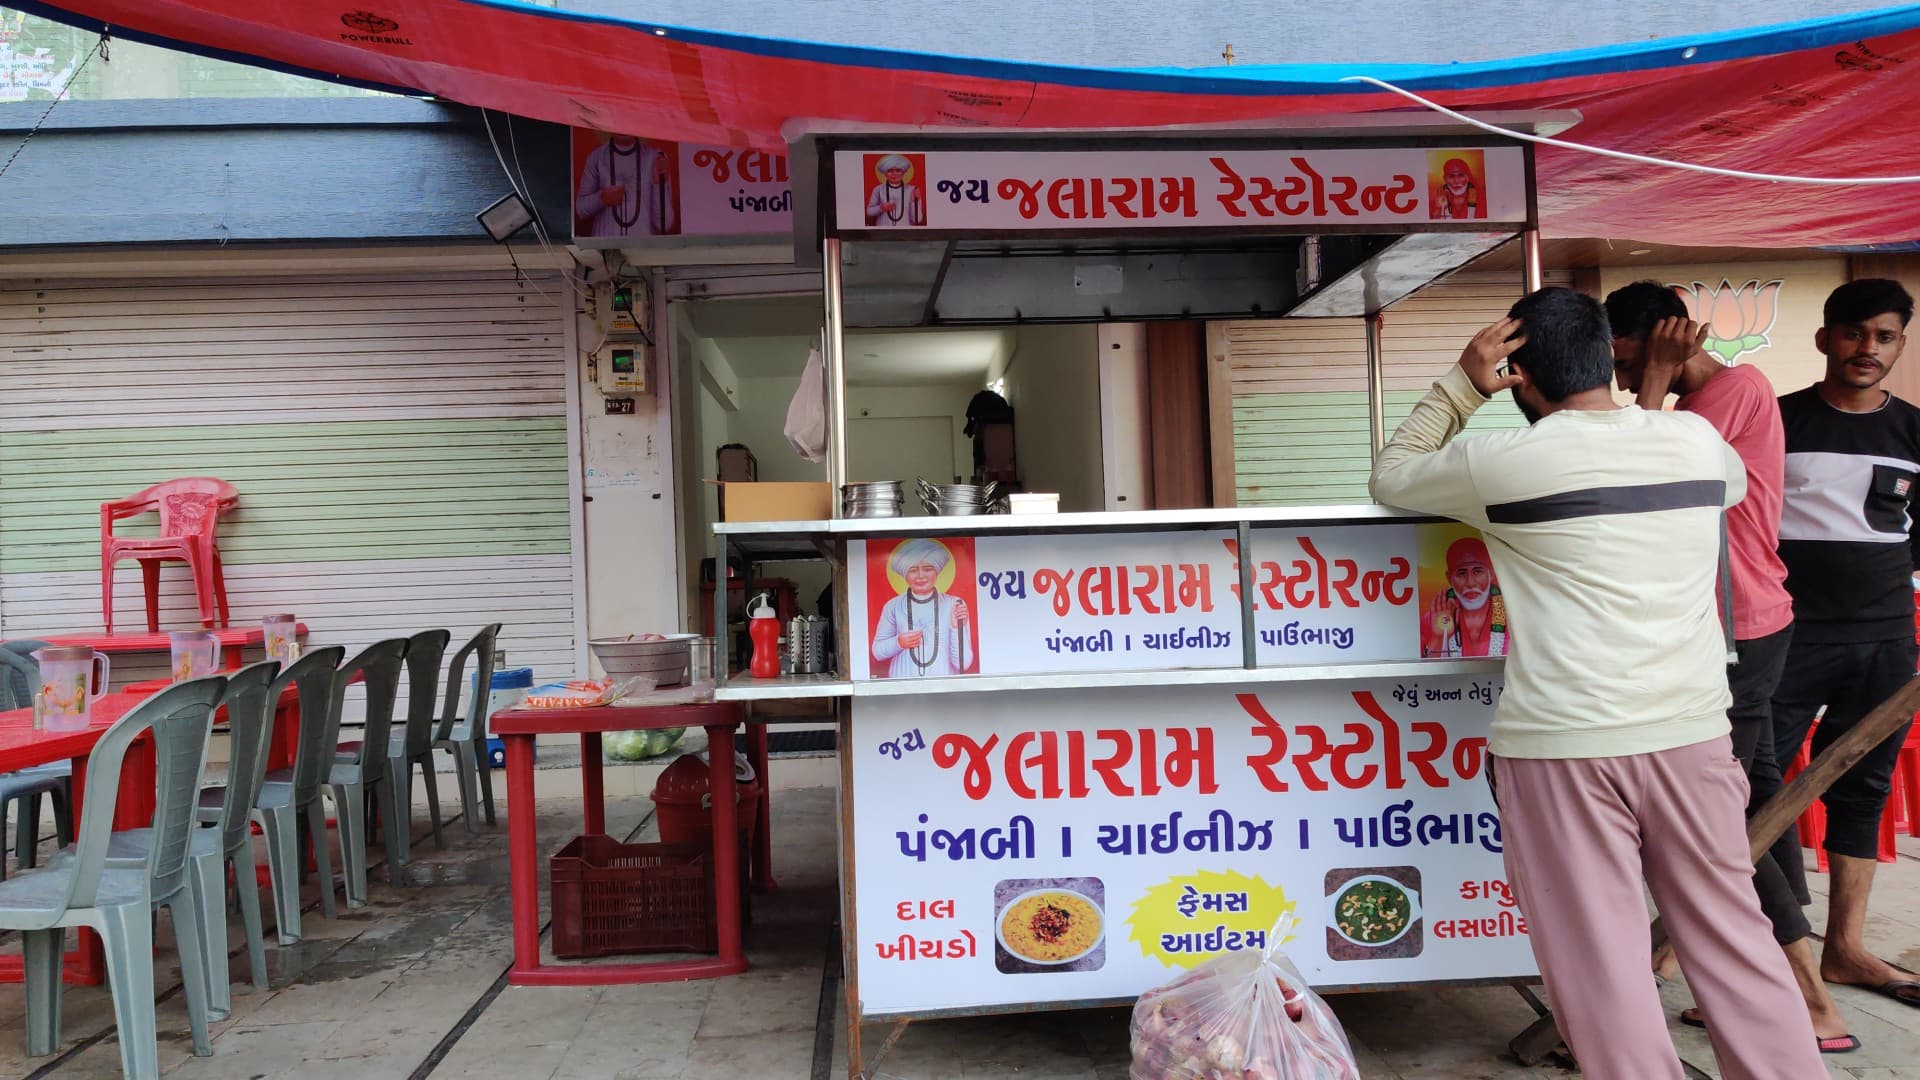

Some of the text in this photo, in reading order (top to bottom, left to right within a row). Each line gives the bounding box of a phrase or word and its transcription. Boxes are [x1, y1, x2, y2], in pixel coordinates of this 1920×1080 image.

[341, 33, 413, 46] POWERBULL
[693, 150, 789, 183] જલા
[937, 158, 1418, 219] જય જલારામ રેસ્ટોરન્ટ
[978, 571, 1027, 600] જય
[1034, 566, 1211, 616] જલારામ
[1045, 628, 1113, 653] પંજાબી
[1143, 626, 1231, 650] ચાઈનીઝ
[1392, 682, 1420, 708] જેવું
[1424, 687, 1462, 702] અન્ન
[1468, 680, 1493, 706] તેવું
[879, 691, 1487, 800] જય જલારામ રેસ્ટોરન્
[897, 814, 1034, 861] પંજાબી
[1097, 810, 1273, 855] ચાઈનીઝ
[1177, 886, 1248, 917] ફેમસ
[1459, 880, 1517, 907] કાજુ
[896, 899, 955, 921] દાલ
[875, 929, 977, 961] ખીચડો
[1162, 926, 1264, 952] આઈટમ
